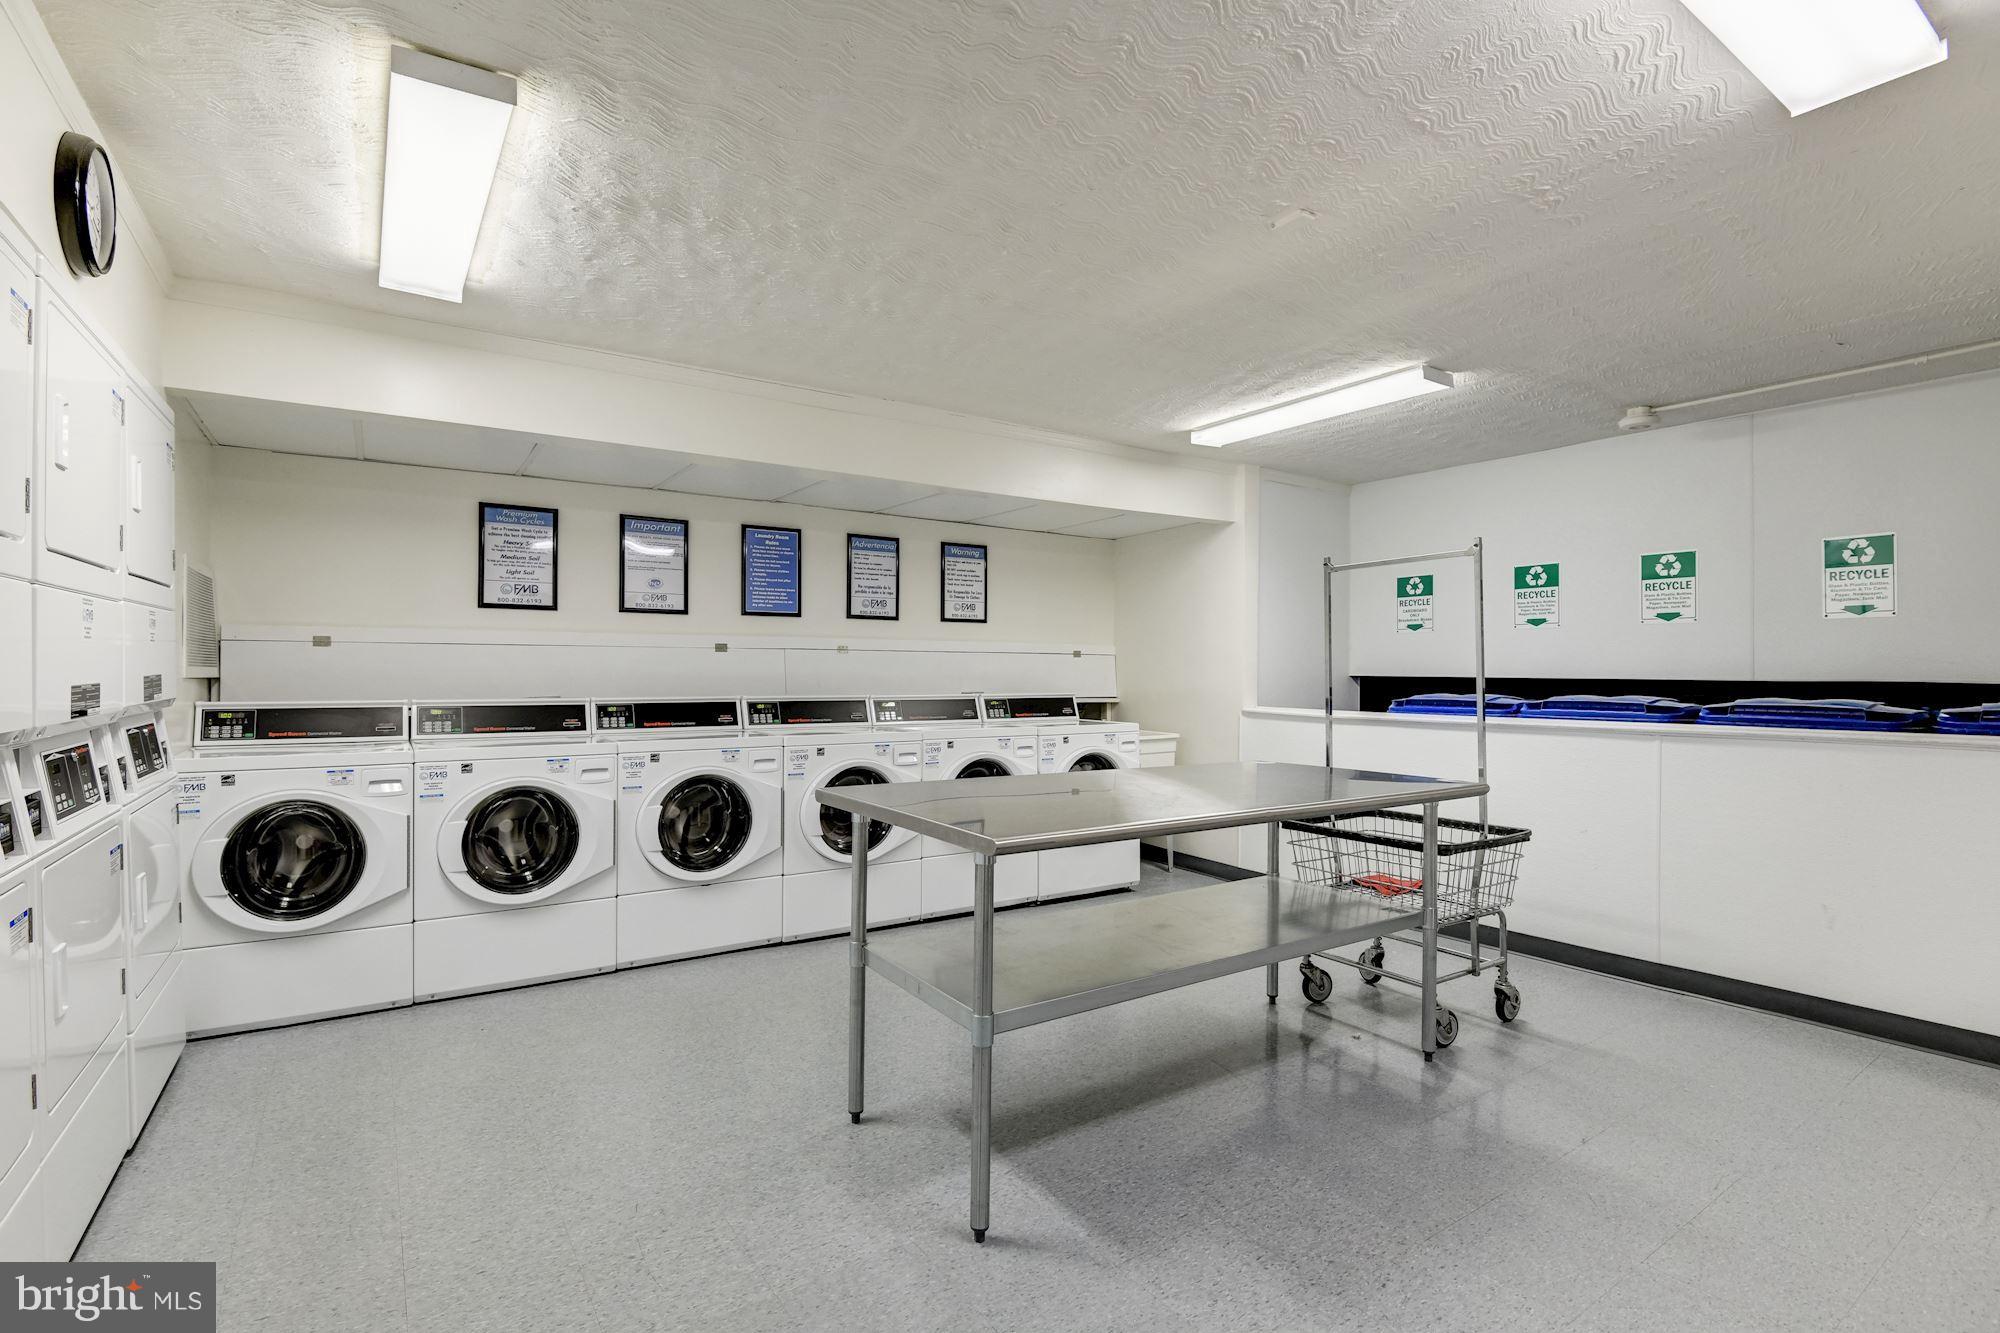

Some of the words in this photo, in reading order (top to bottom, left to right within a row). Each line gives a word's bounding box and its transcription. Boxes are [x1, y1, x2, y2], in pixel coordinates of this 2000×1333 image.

[503, 510, 538, 518] Premium
[520, 517, 544, 526] Cycles
[630, 520, 681, 532] Important
[951, 548, 980, 558] Warning
[1829, 568, 1890, 581] RECYCLE
[514, 584, 539, 595] FMB
[1645, 581, 1692, 591] RECYCLE
[1517, 590, 1556, 599] RECYCLE
[871, 600, 887, 608] FMB
[1400, 598, 1431, 607] RECYCLE
[429, 771, 447, 780] FMB
[184, 783, 206, 793] FMB
